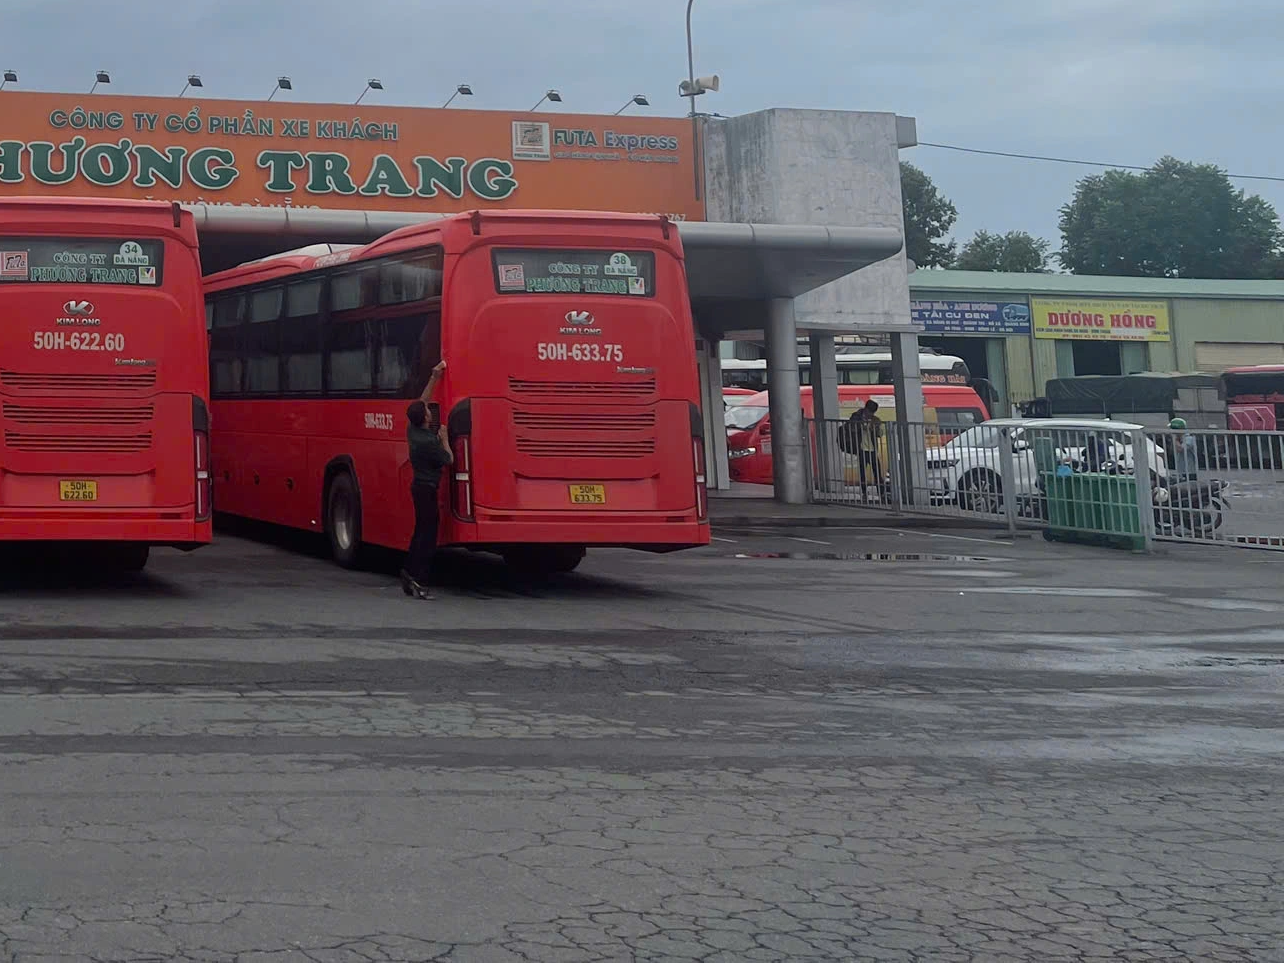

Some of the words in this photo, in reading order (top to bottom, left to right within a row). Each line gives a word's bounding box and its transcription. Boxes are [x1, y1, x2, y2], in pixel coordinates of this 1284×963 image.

[49, 106, 124, 130] CÔNG
[132, 112, 158, 131] TY
[164, 105, 202, 134] CỔ
[208, 109, 274, 137] PHẦN
[281, 118, 310, 138] XE
[316, 117, 399, 141] KHÁCH
[553, 129, 598, 148] FUTA
[603, 130, 679, 152] Express
[256, 150, 518, 200] TRANG
[124, 244, 139, 255] 34
[53, 251, 88, 265] CÔNG
[90, 253, 107, 265] TY
[30, 265, 88, 283] PHƯƠNG
[90, 267, 138, 284] TRANG
[548, 261, 581, 275] CÔNG
[582, 264, 600, 276] TY
[526, 276, 581, 293] PHƯƠNG
[582, 277, 627, 294] TRANG
[56, 318, 75, 326] KIM
[76, 318, 101, 326] LONG
[1048, 309, 1105, 328] DƯƠNG
[1109, 308, 1157, 329] HỒNG
[559, 327, 577, 335] KIM
[578, 328, 602, 336] LONG
[33, 332, 125, 352] 50H-622.60
[538, 343, 624, 362] 50H-633.75
[70, 481, 87, 491] 50H
[579, 485, 596, 494] 50H
[64, 490, 94, 500] 622.60
[574, 494, 603, 503] 633.75
